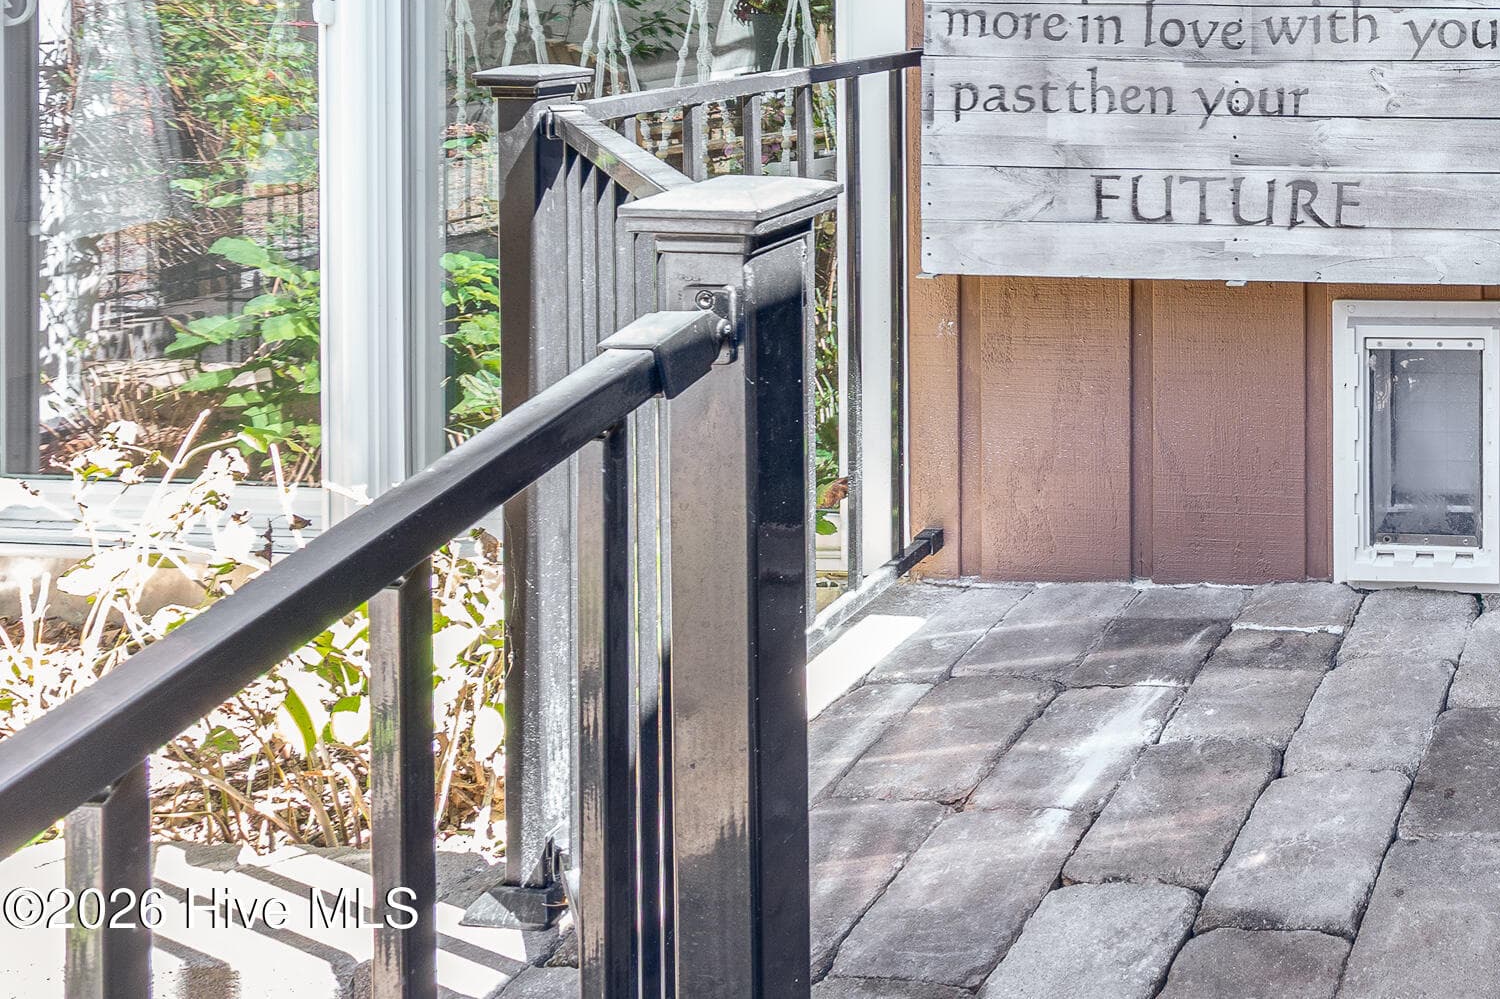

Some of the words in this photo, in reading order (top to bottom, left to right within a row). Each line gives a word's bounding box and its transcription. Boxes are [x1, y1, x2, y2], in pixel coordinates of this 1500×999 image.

[943, 6, 1068, 45] more
[1080, 0, 1122, 45] in
[1144, 0, 1246, 50] love
[1191, 85, 1310, 128] your
[1090, 174, 1366, 230] FUTURE
